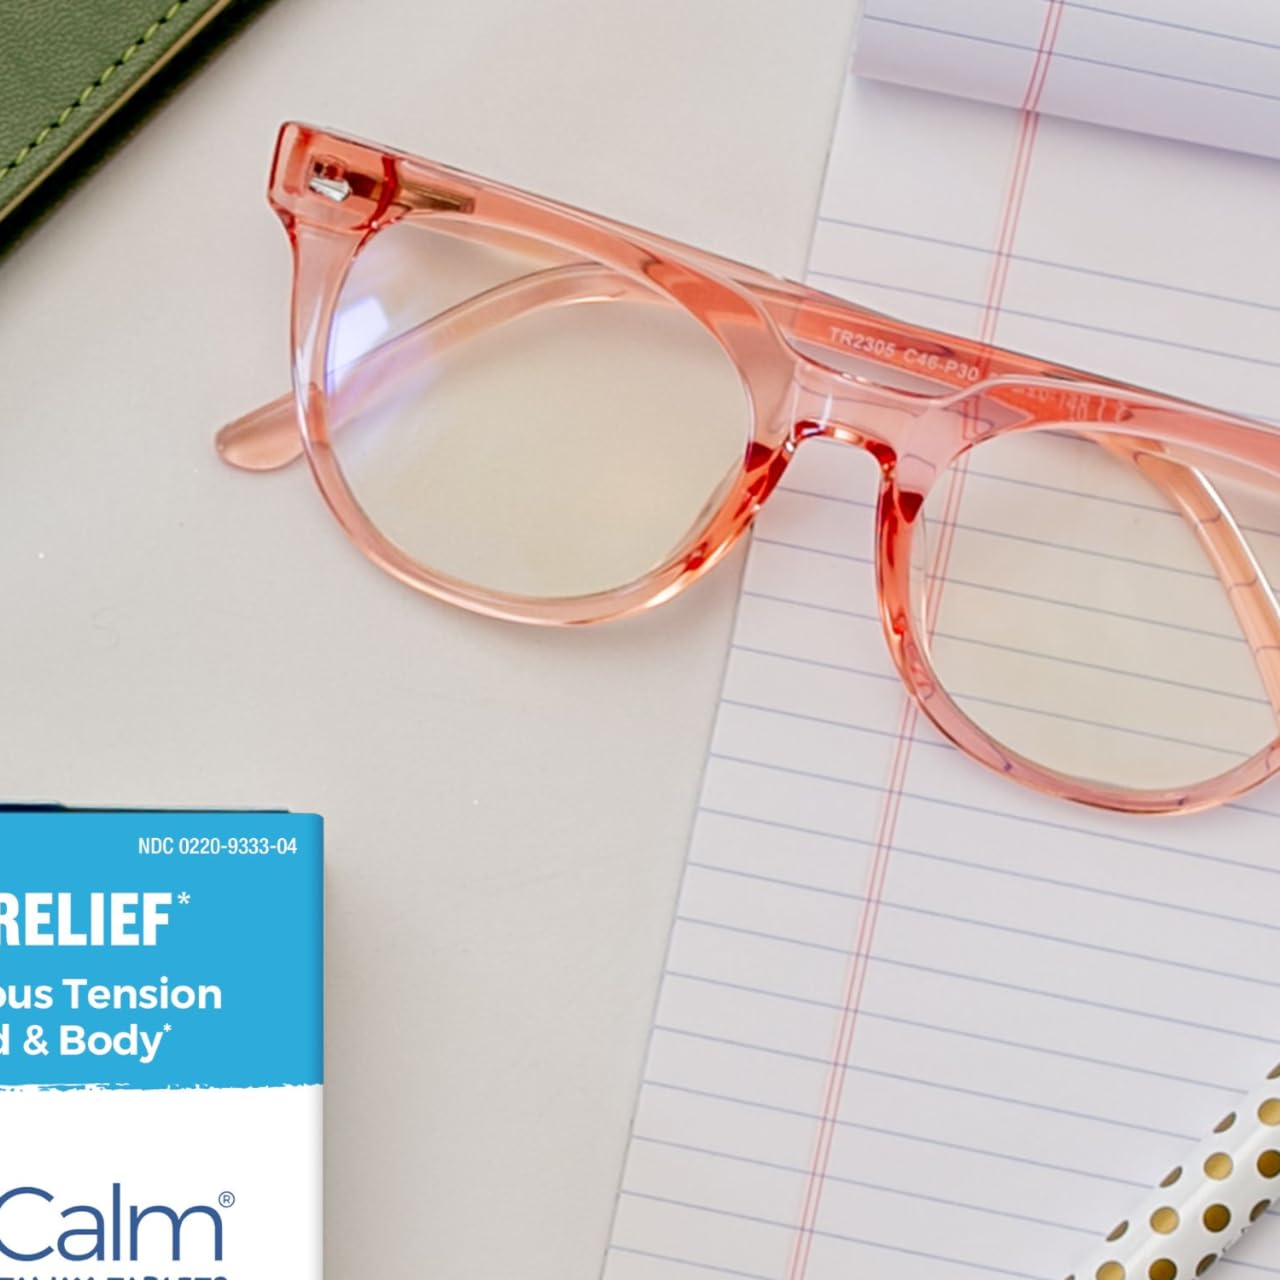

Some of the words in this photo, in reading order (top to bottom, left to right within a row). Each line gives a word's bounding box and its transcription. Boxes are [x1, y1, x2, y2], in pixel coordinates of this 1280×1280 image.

[139, 837, 174, 855] NDC
[179, 837, 297, 854] 0220-9333-04
[62, 976, 221, 1009] Tension
[23, 1025, 49, 1056] &
